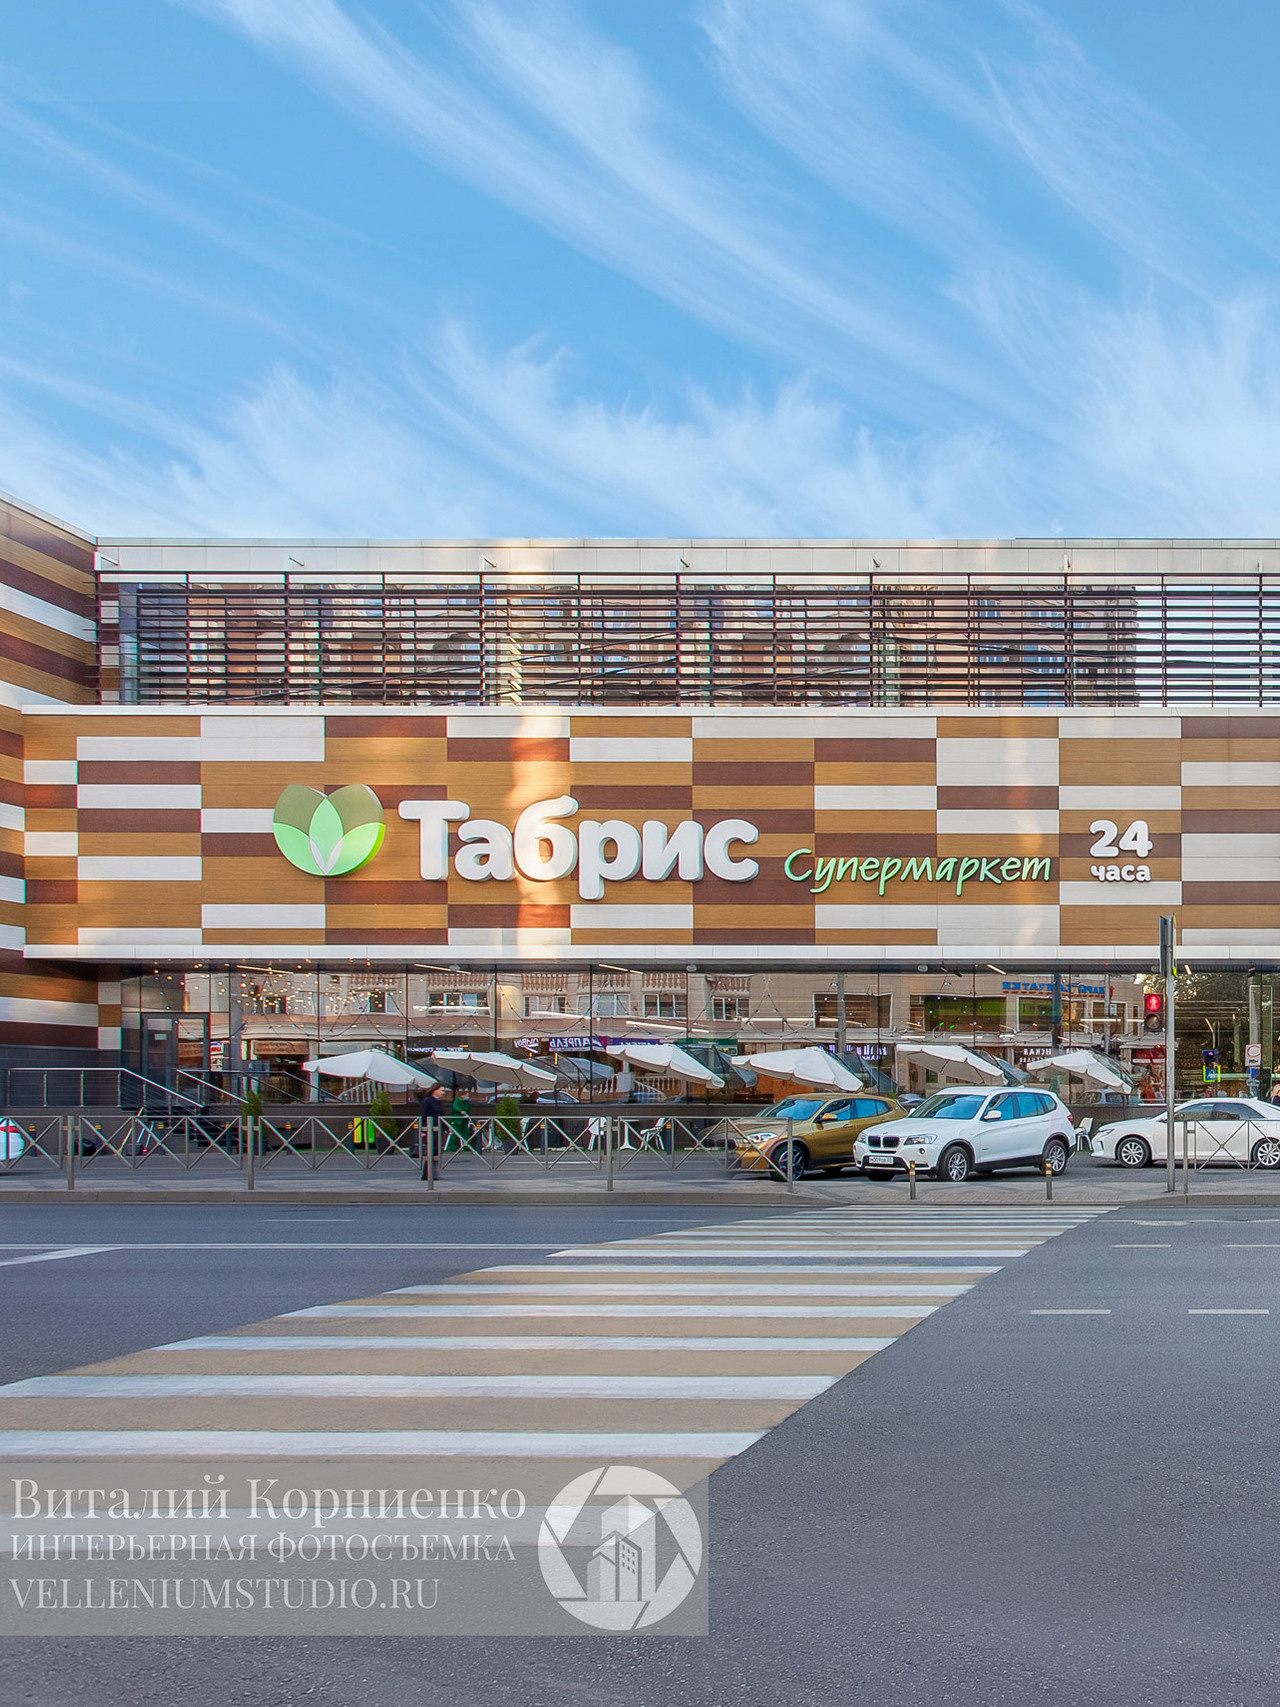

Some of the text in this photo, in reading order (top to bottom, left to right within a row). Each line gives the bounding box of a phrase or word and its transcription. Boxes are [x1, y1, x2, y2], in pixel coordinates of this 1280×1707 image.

[398, 794, 760, 900] Табрис
[1089, 819, 1154, 858] 24
[783, 848, 1052, 896] Супермаркет
[1090, 862, 1152, 882] часа
